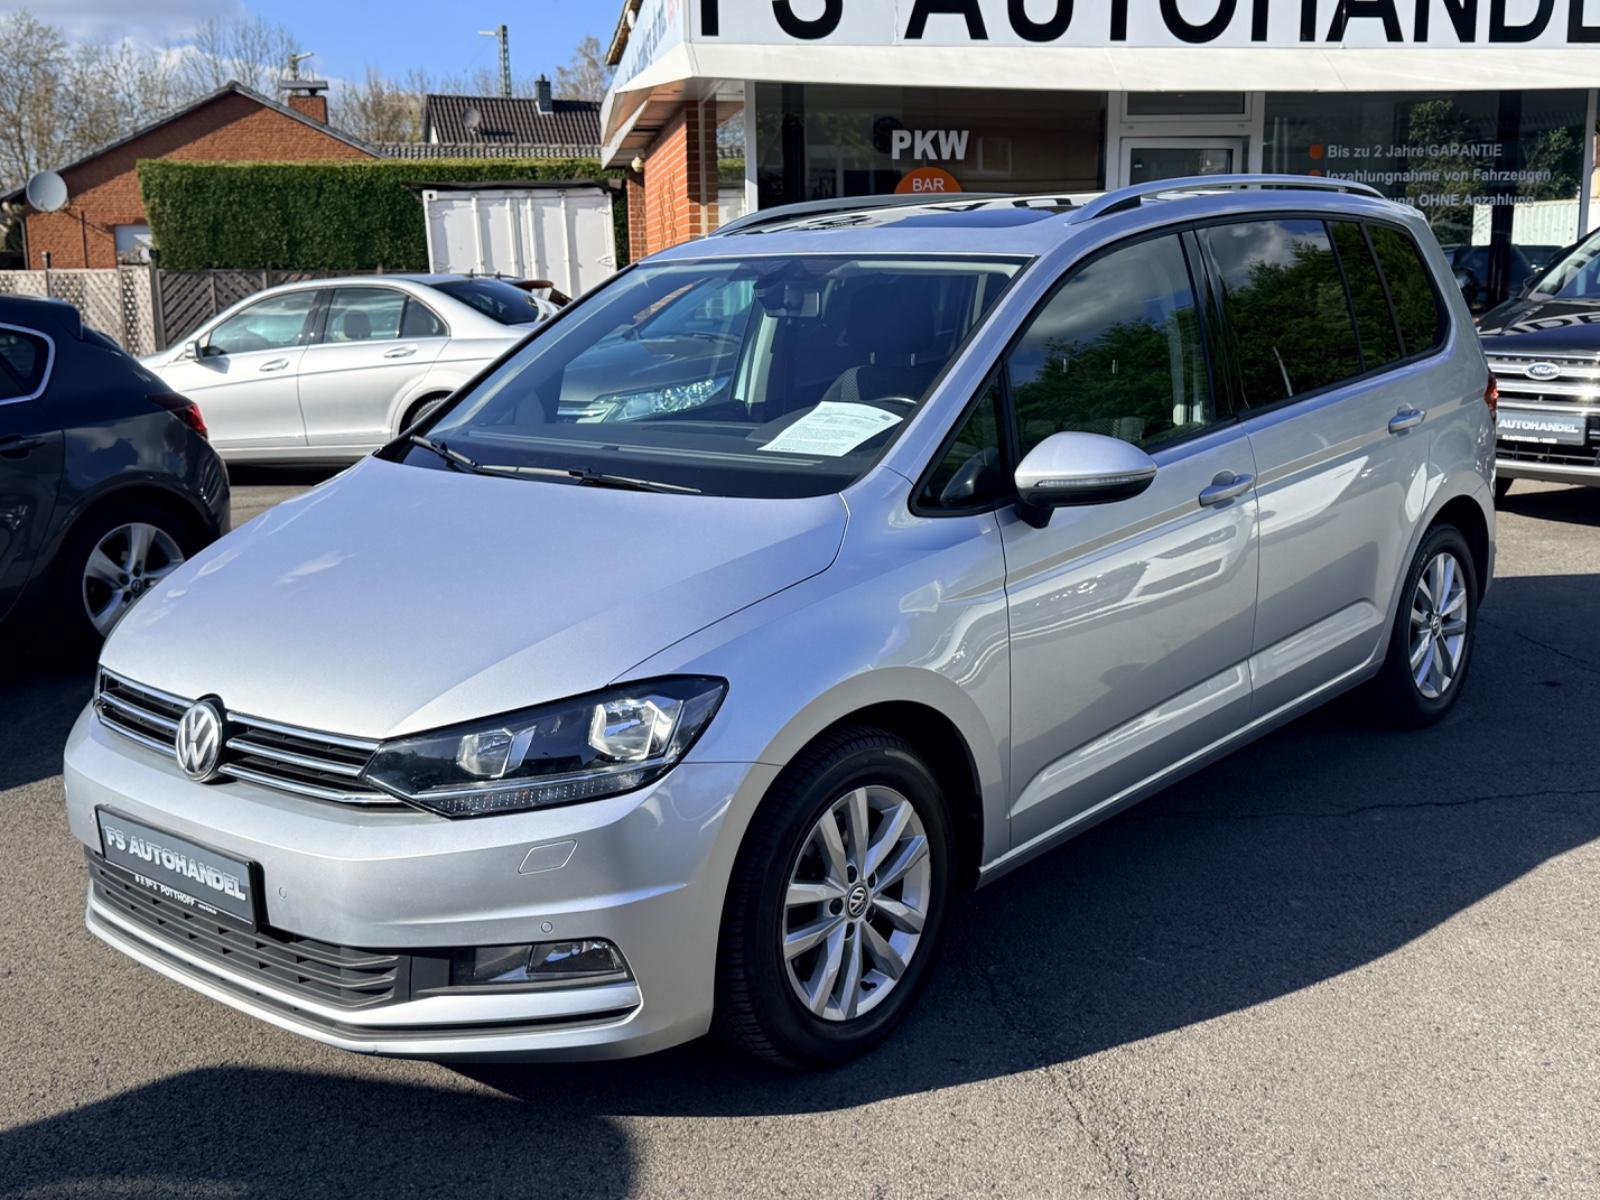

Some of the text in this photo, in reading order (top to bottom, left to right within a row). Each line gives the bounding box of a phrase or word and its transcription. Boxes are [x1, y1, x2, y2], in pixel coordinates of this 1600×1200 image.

[891, 129, 970, 160] PKW
[1327, 144, 1503, 158] Bis zu 2 Jahre GARANTIE
[1443, 171, 1469, 181] von
[1472, 169, 1552, 184] Fahrzeugen
[912, 177, 945, 192] BAR
[1418, 193, 1459, 207] OHNE
[1463, 192, 1535, 208] Anzahlung
[1498, 419, 1579, 434] AUTOHANDEL
[104, 825, 246, 901] FS AUTOHANDEL
